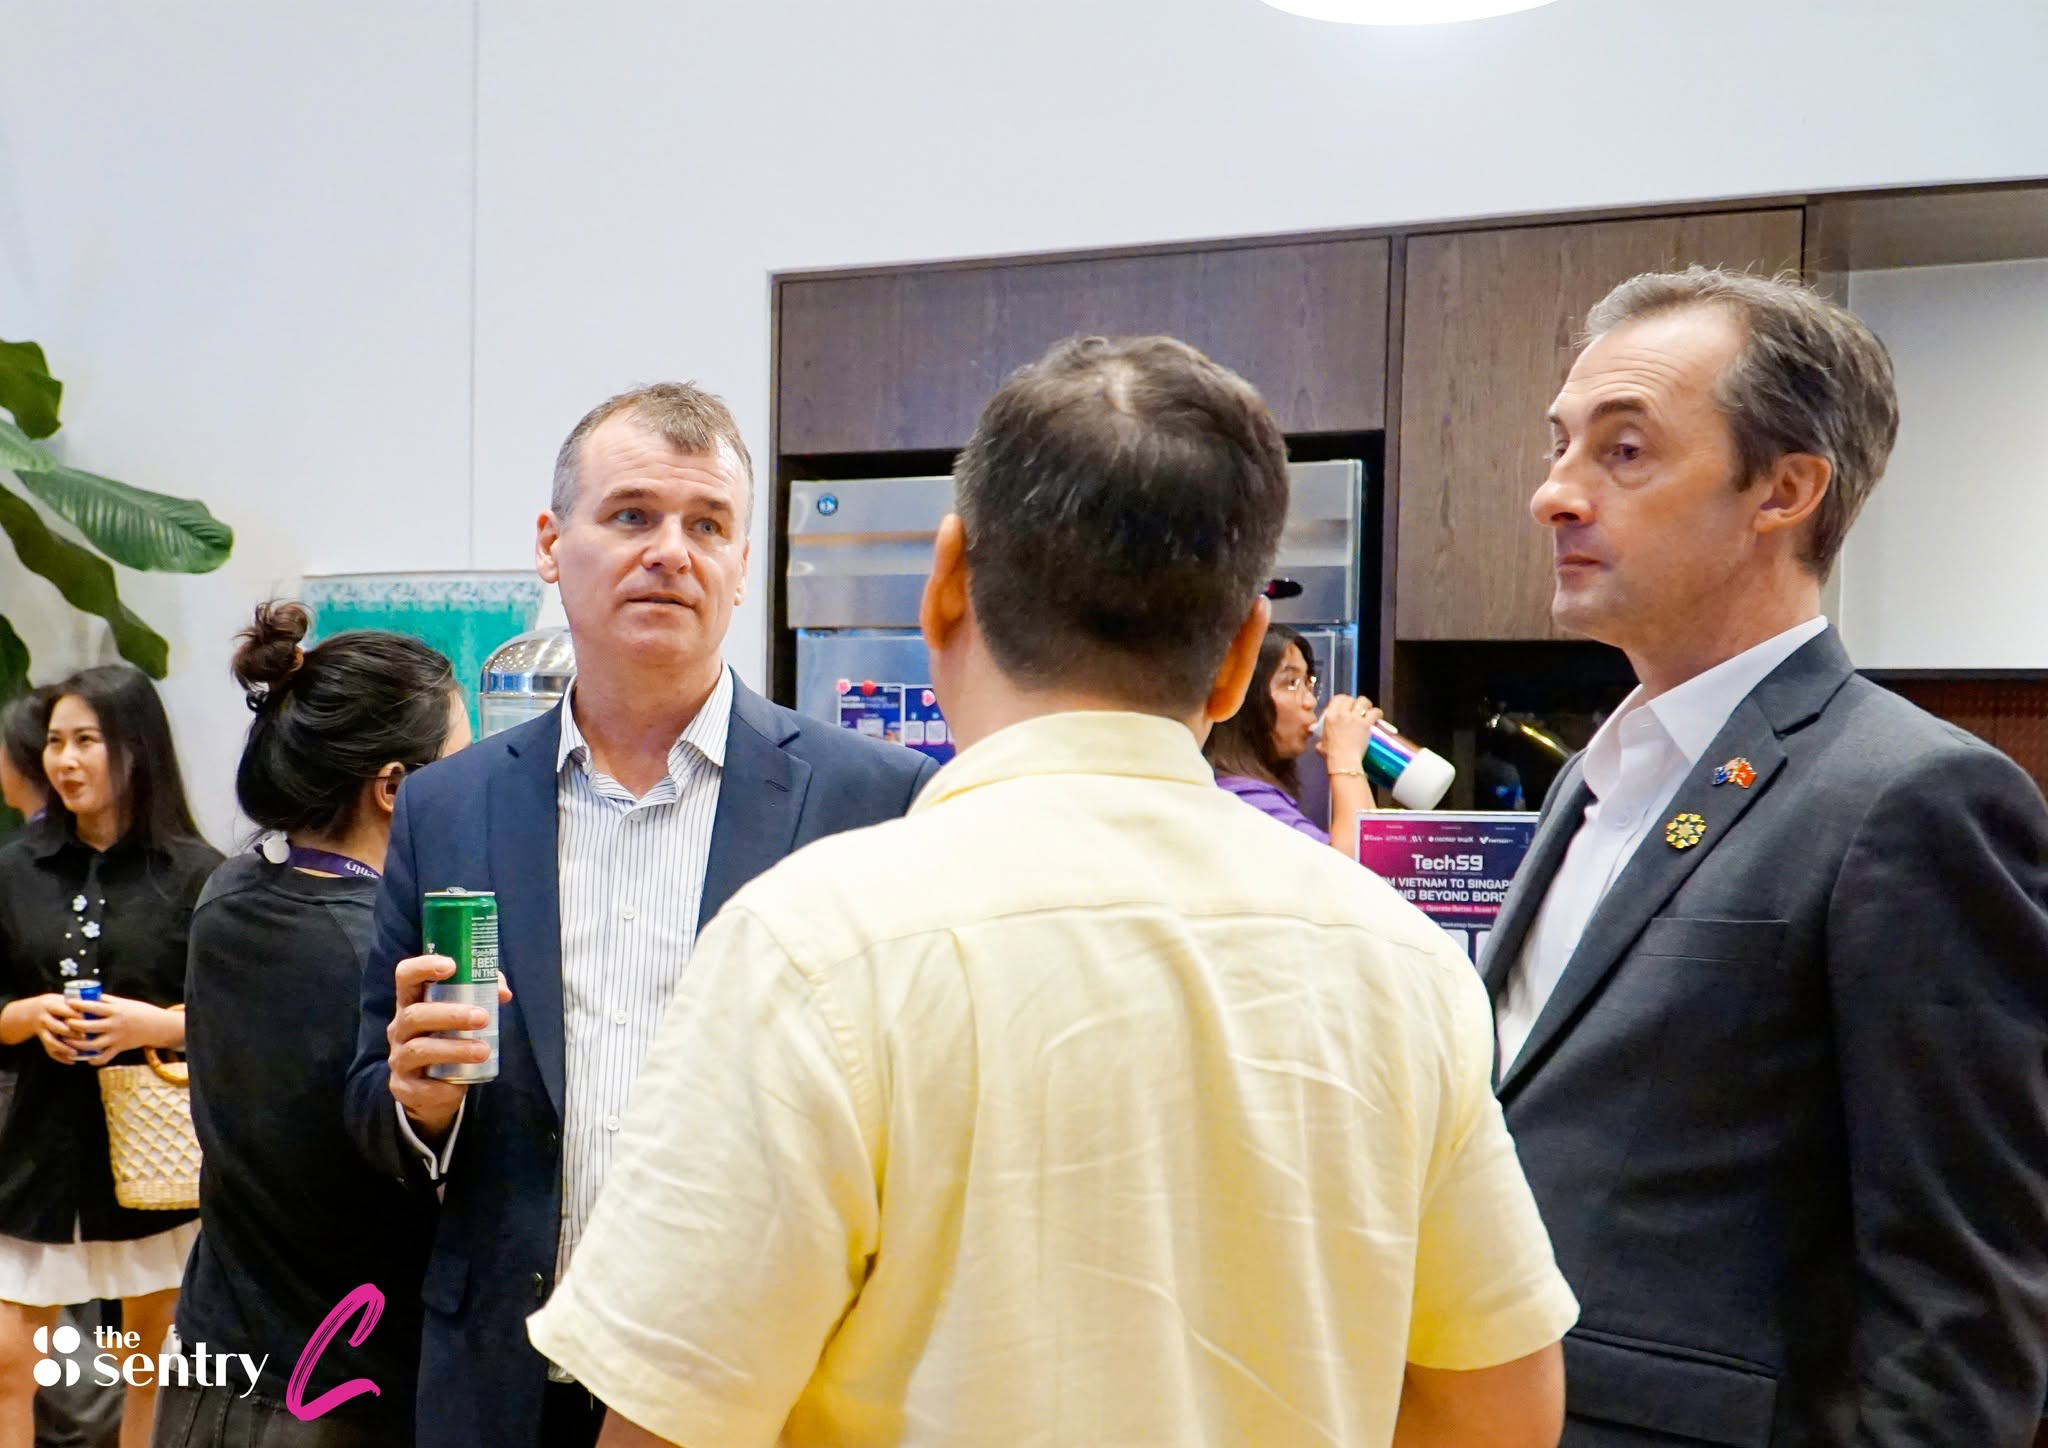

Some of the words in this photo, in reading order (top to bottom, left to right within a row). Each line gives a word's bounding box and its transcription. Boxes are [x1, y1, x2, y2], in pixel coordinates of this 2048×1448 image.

[1398, 877, 1447, 888] VIETNAM
[1449, 878, 1465, 889] TO
[1467, 879, 1511, 890] SINGAP
[1419, 890, 1469, 902] BEYOND
[477, 957, 497, 968] BEST
[472, 969, 481, 978] IN
